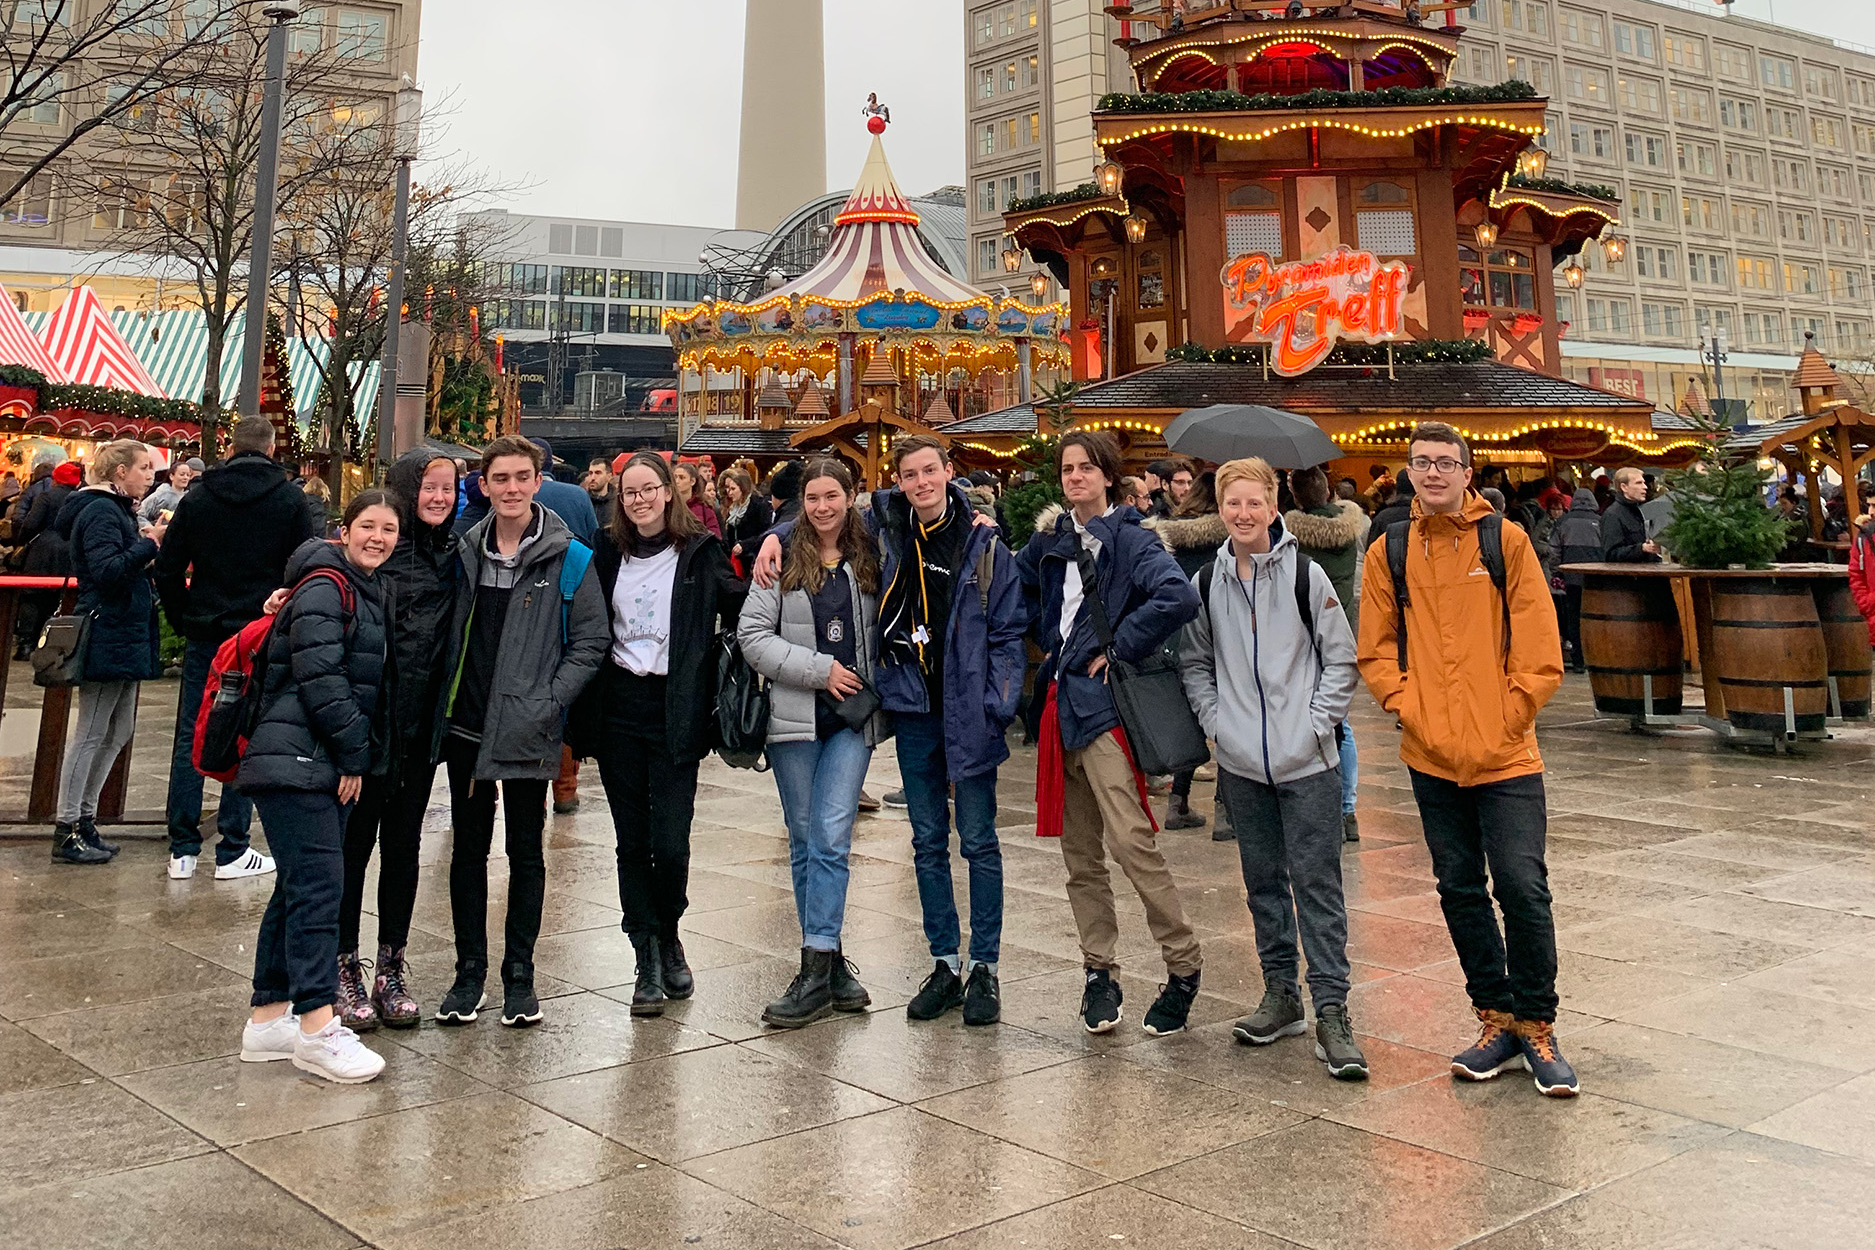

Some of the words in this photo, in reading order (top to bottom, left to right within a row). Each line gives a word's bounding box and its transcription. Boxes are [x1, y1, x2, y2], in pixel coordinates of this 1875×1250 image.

[1228, 250, 1371, 301] Pyramiden
[1261, 266, 1402, 372] Treff
[723, 395, 741, 410] 19
[1604, 378, 1639, 397] BEST
